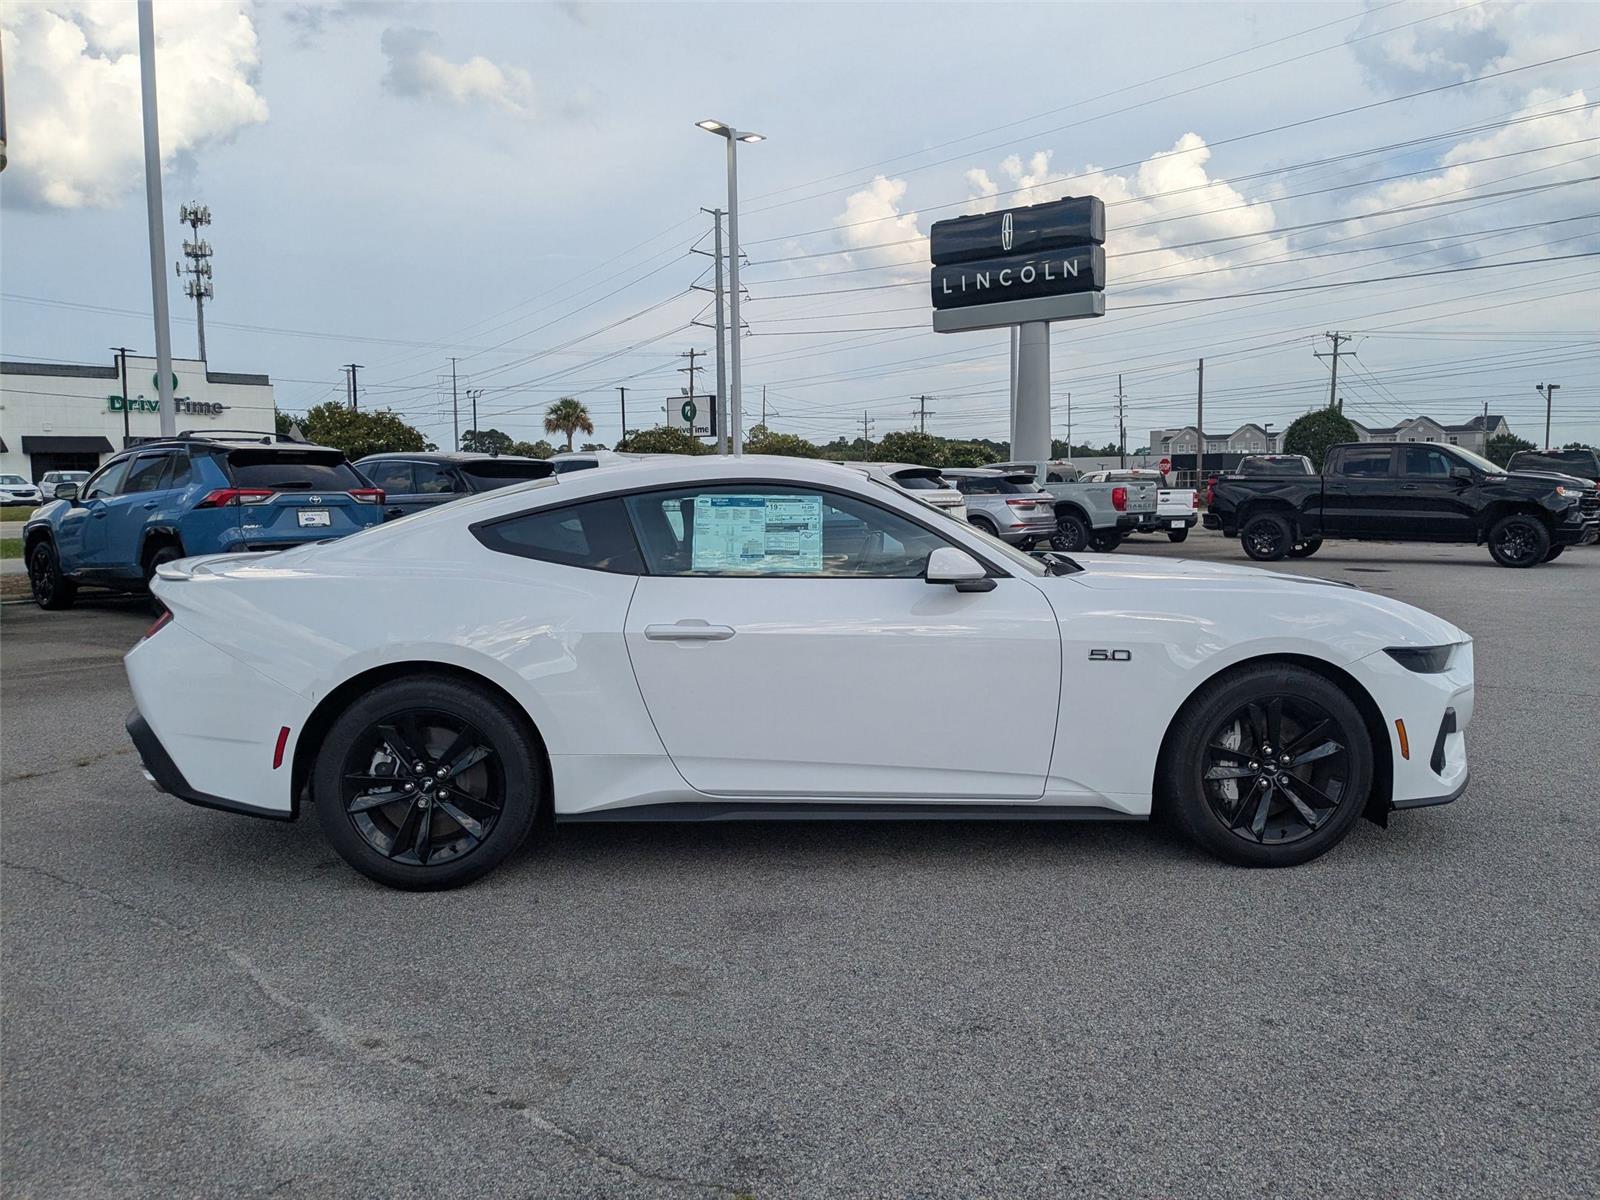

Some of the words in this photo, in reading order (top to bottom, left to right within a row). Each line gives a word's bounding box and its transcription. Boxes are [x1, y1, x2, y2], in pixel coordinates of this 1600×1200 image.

[943, 259, 1078, 294] LINCOLN
[109, 395, 223, 414] DrivTime
[1088, 649, 1131, 661] 5.0
